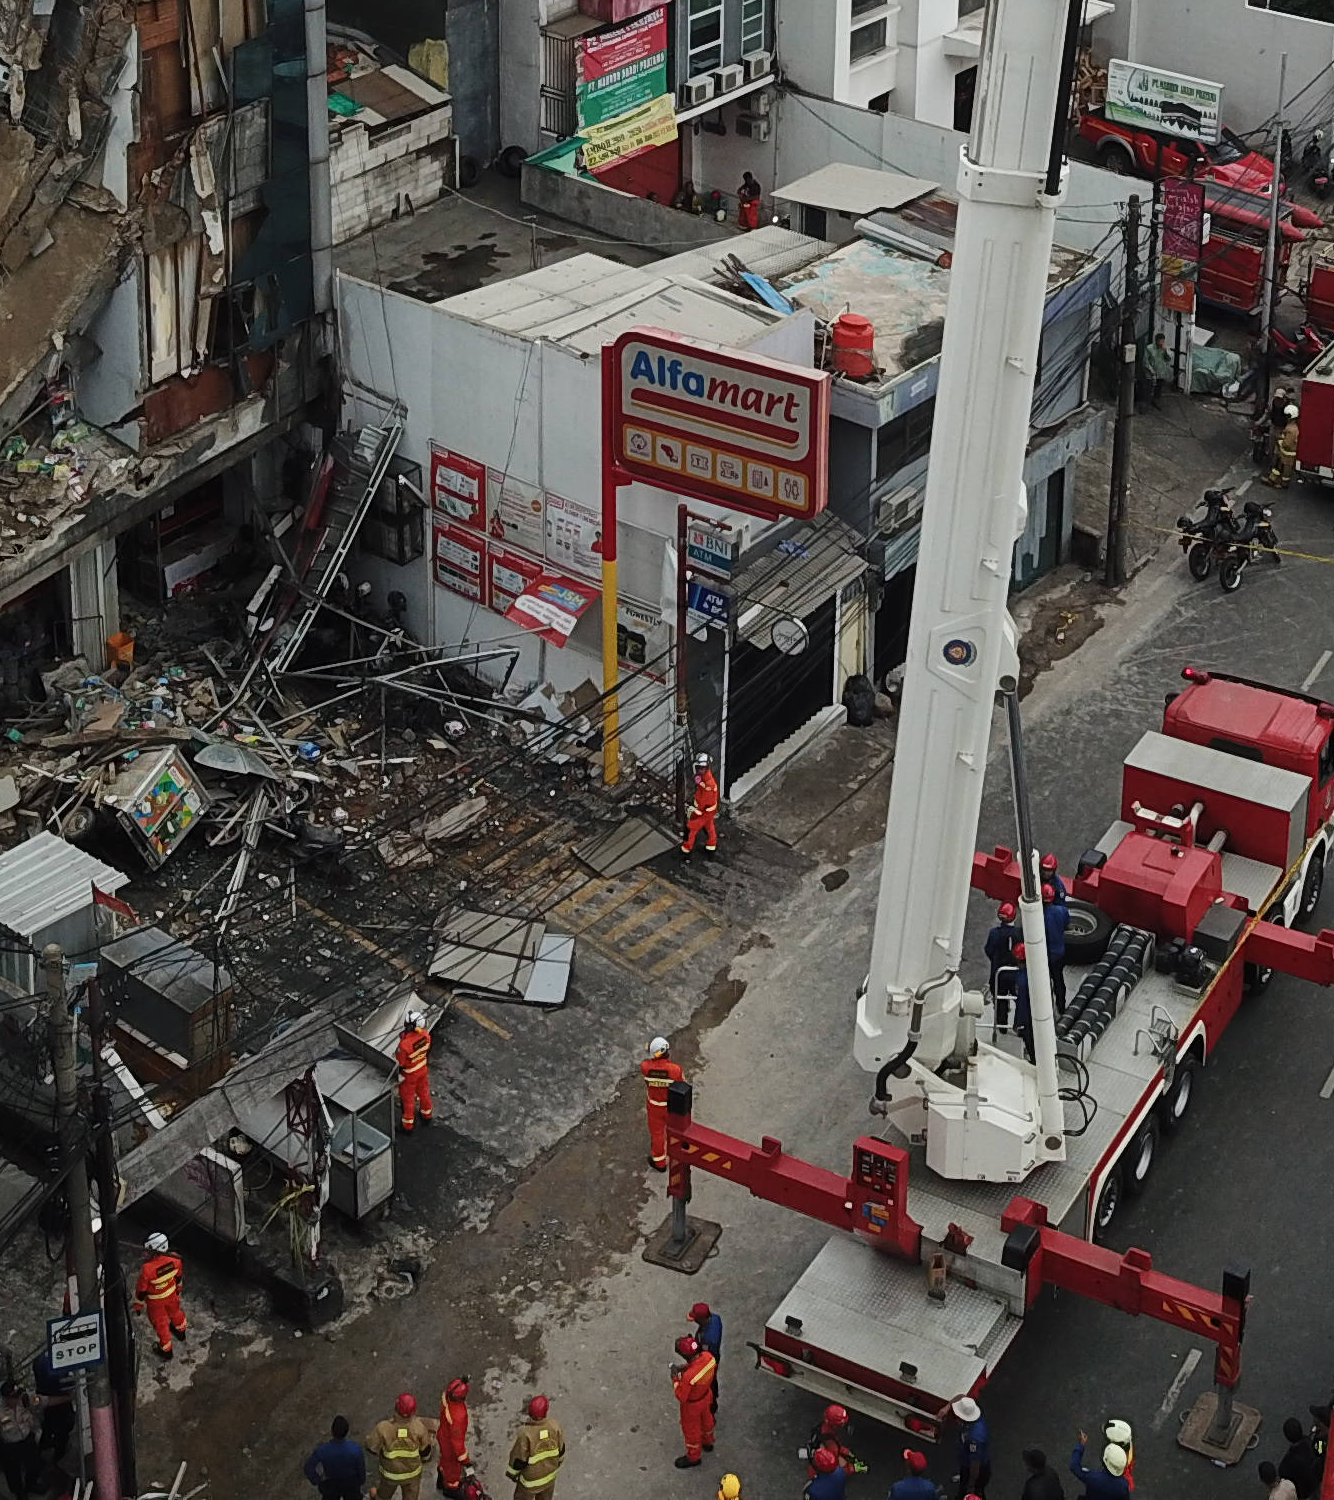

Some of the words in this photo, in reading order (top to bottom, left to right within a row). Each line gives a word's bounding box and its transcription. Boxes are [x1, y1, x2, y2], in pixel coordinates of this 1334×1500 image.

[630, 349, 800, 424] Alfamart
[693, 547, 713, 563] ATM
[706, 535, 728, 557] BNI
[557, 588, 589, 608] JSM
[706, 593, 724, 607] ATM
[55, 1342, 98, 1361] STOP
